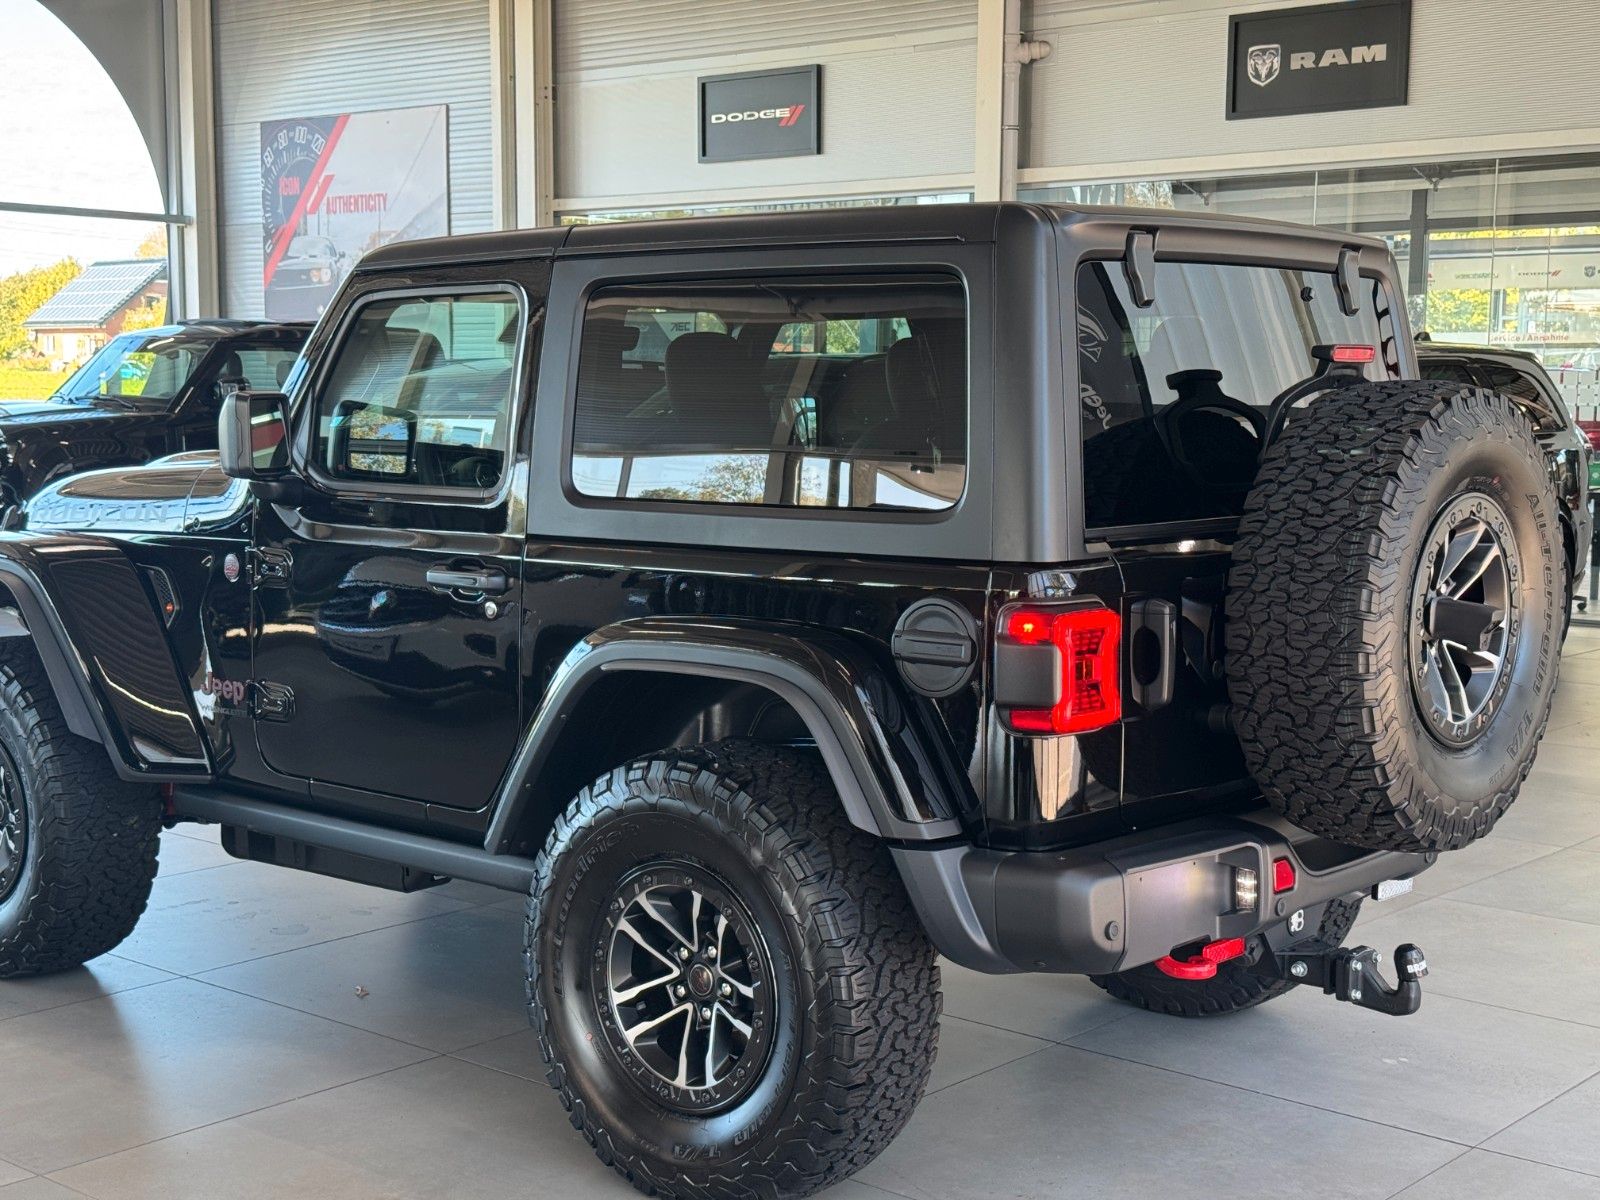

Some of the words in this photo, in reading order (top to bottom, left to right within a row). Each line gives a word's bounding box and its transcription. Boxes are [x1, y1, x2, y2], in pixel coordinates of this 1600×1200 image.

[1290, 43, 1387, 70] RAM
[710, 107, 791, 124] DODGE
[326, 193, 388, 215] AUTHENTICITY
[200, 671, 245, 705] Jeep
